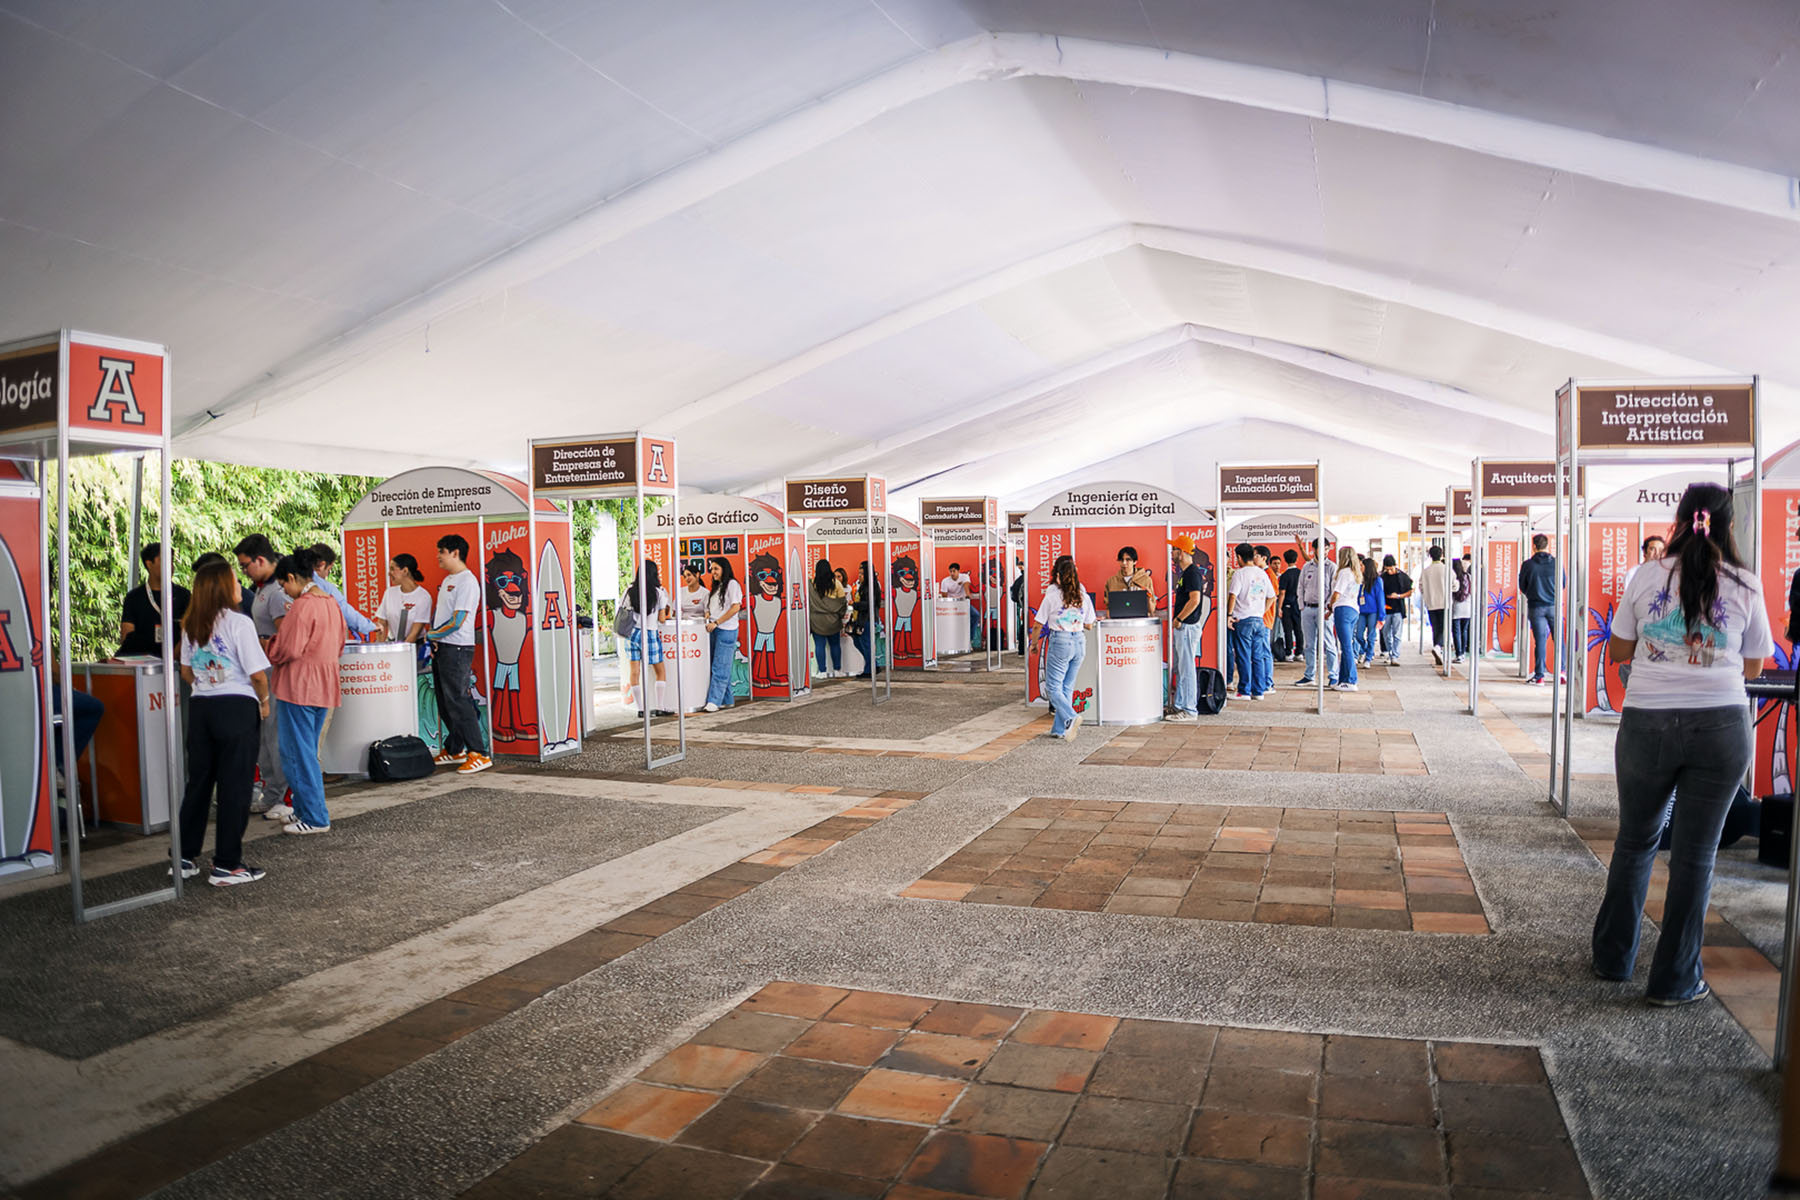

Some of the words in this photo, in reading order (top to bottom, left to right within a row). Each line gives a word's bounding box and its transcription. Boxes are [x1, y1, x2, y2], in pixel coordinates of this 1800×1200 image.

[0, 370, 51, 410] logía
[87, 356, 145, 425] A
[1615, 393, 1699, 408] Dirección
[1703, 395, 1714, 407] e
[1602, 409, 1728, 427] Interpretación
[1626, 427, 1704, 441] Artística
[553, 447, 600, 460] Dirección
[602, 446, 615, 457] de
[553, 461, 601, 473] Empresas
[603, 458, 616, 468] de
[648, 444, 668, 482] A
[545, 470, 625, 484] Entretenimiento
[1235, 474, 1286, 485] Ingeniería
[371, 488, 419, 503] Dirección
[421, 487, 435, 499] de
[437, 485, 491, 499] Empresas
[804, 484, 847, 496] Diseño
[872, 482, 883, 508] A
[1224, 484, 1278, 493] Animación
[1279, 483, 1313, 494] Digital
[803, 496, 849, 509] Gráfico
[1067, 490, 1138, 505] Ingeniería
[1141, 492, 1158, 501] en
[381, 506, 394, 517] de
[396, 501, 481, 516] Entretenimiento
[1052, 504, 1126, 516] Animación
[1129, 502, 1175, 517] Digital
[707, 510, 759, 524] Gráfico
[833, 518, 868, 526] Finanza
[874, 518, 880, 526] y
[816, 528, 863, 536] Contaduría
[865, 526, 898, 535] úblca
[1241, 523, 1277, 531] Ingeniería
[1279, 522, 1314, 530] Industrial
[485, 524, 528, 550] Aloha
[934, 533, 983, 541] rnacionales
[1179, 527, 1215, 542] oha
[692, 542, 702, 552] Ps
[709, 541, 718, 551] Id
[725, 540, 736, 550] Ae
[749, 536, 783, 554] Aloha
[891, 543, 920, 557] Aloha
[1599, 528, 1613, 595] ANÁHUAC
[1780, 498, 1800, 612] ÁHUAC
[1037, 534, 1050, 594] ANÁHUAC
[1504, 544, 1512, 589] VERACRUZ
[355, 537, 368, 612] ANÁHUAC
[367, 536, 379, 620] VERACRUZ
[791, 582, 803, 610] A
[541, 591, 565, 630] A
[659, 631, 698, 644] iseño
[662, 645, 701, 660] áico
[339, 660, 374, 671] cción
[377, 660, 391, 670] de
[339, 673, 377, 684] presas
[379, 672, 392, 681] de
[340, 684, 409, 696] retenimiento
